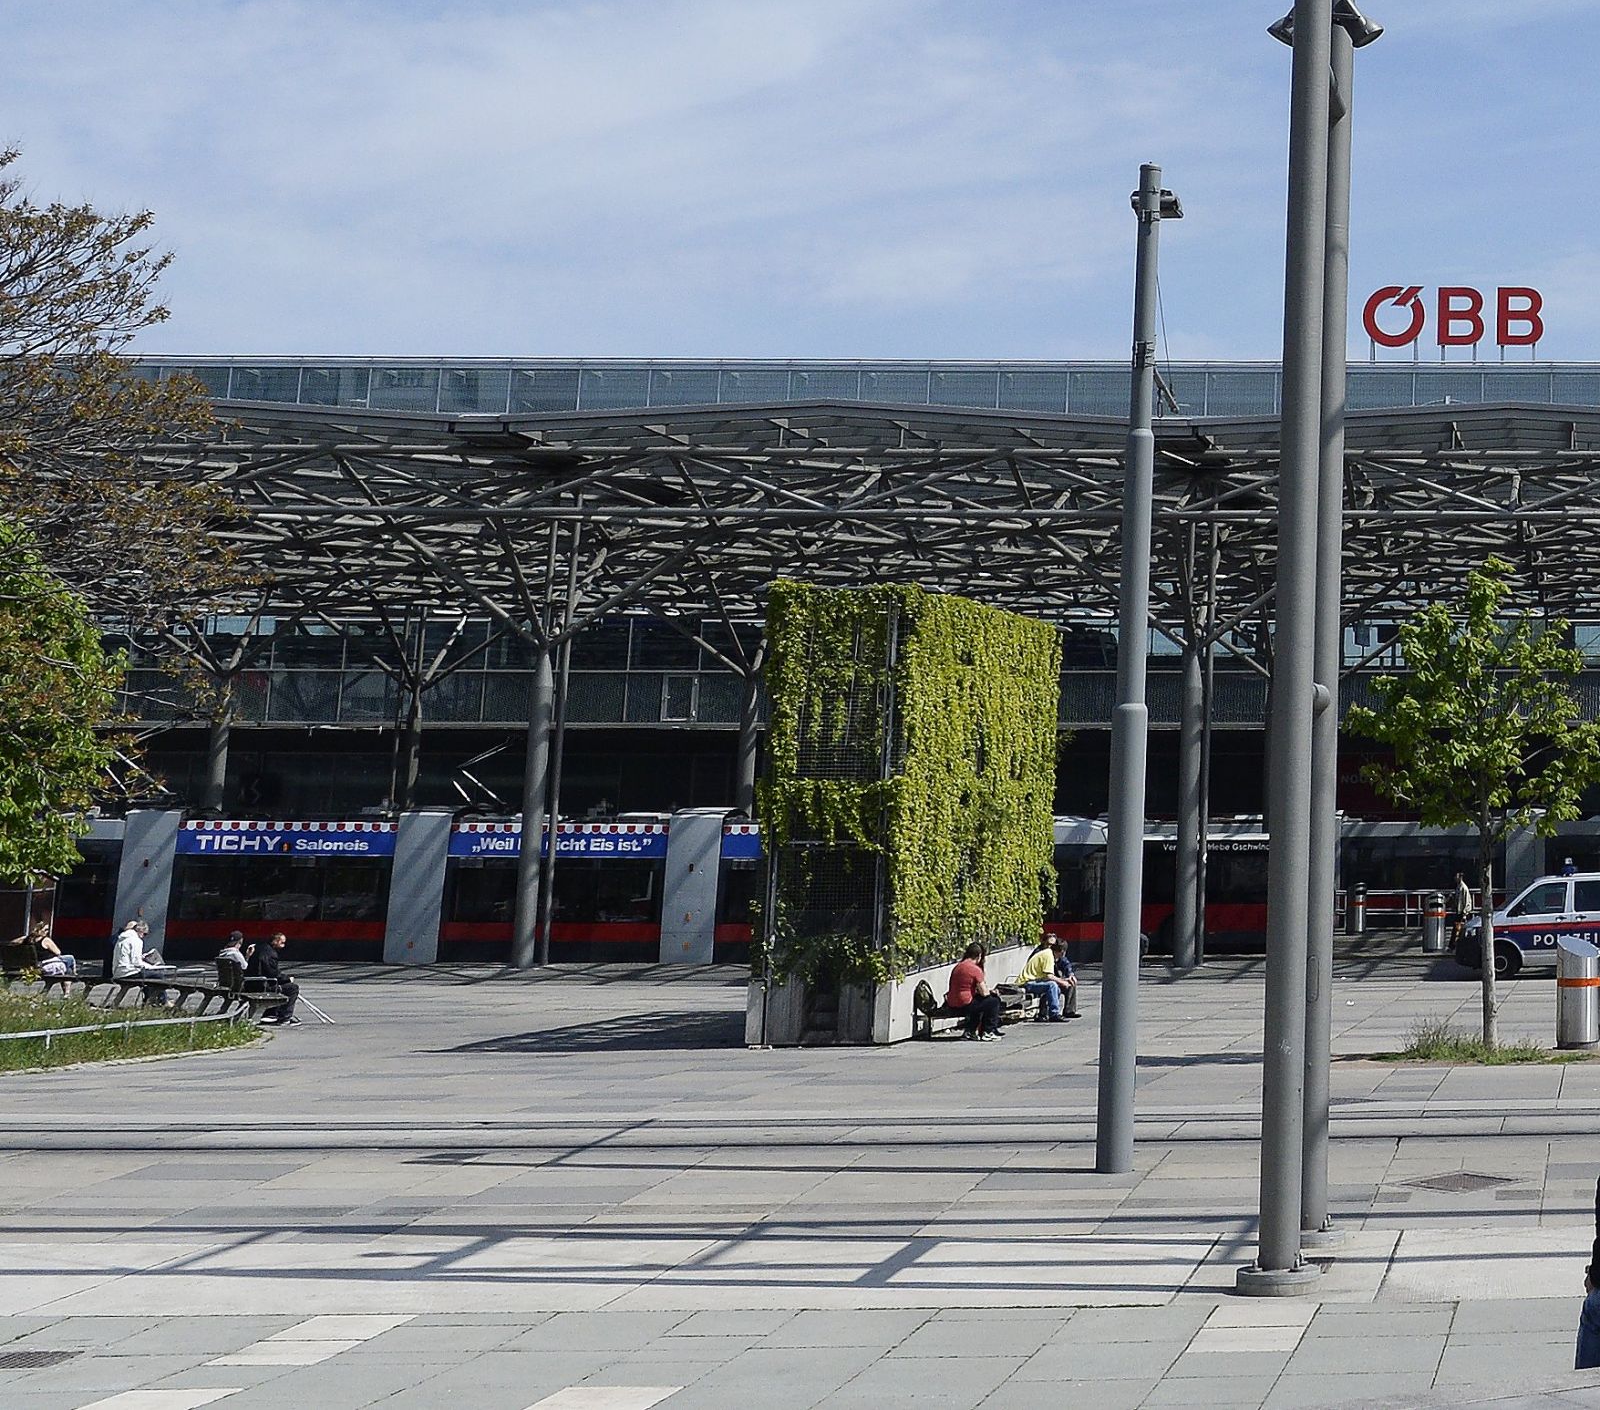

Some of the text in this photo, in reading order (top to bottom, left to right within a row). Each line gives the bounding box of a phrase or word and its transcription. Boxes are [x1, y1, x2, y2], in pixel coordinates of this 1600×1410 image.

[1363, 286, 1544, 347] ÖBB
[196, 835, 369, 851] TICHY Saloneis
[590, 838, 614, 851] Eis
[1533, 932, 1599, 946] POZEI
